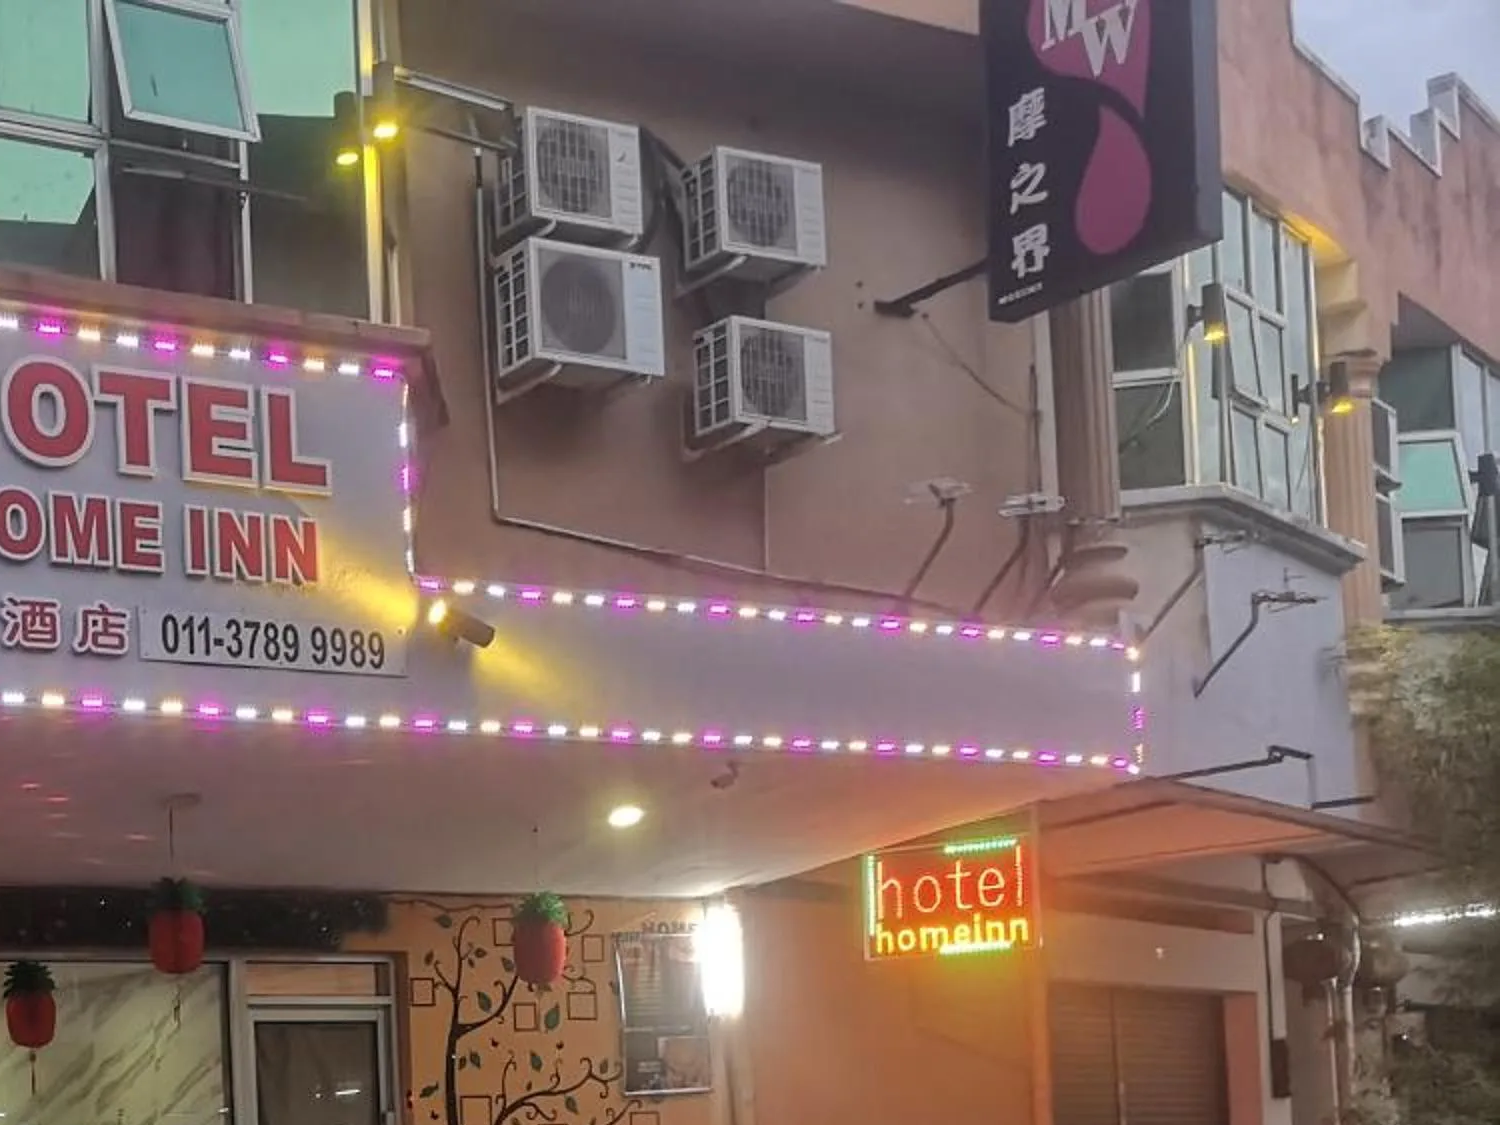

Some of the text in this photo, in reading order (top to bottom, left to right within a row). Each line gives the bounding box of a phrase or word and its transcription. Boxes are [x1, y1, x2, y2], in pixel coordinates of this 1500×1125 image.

[184, 503, 318, 585] INN
[161, 613, 386, 671] 011-3789 9989
[876, 845, 1023, 921] hotel
[875, 913, 1030, 954] homeinn
